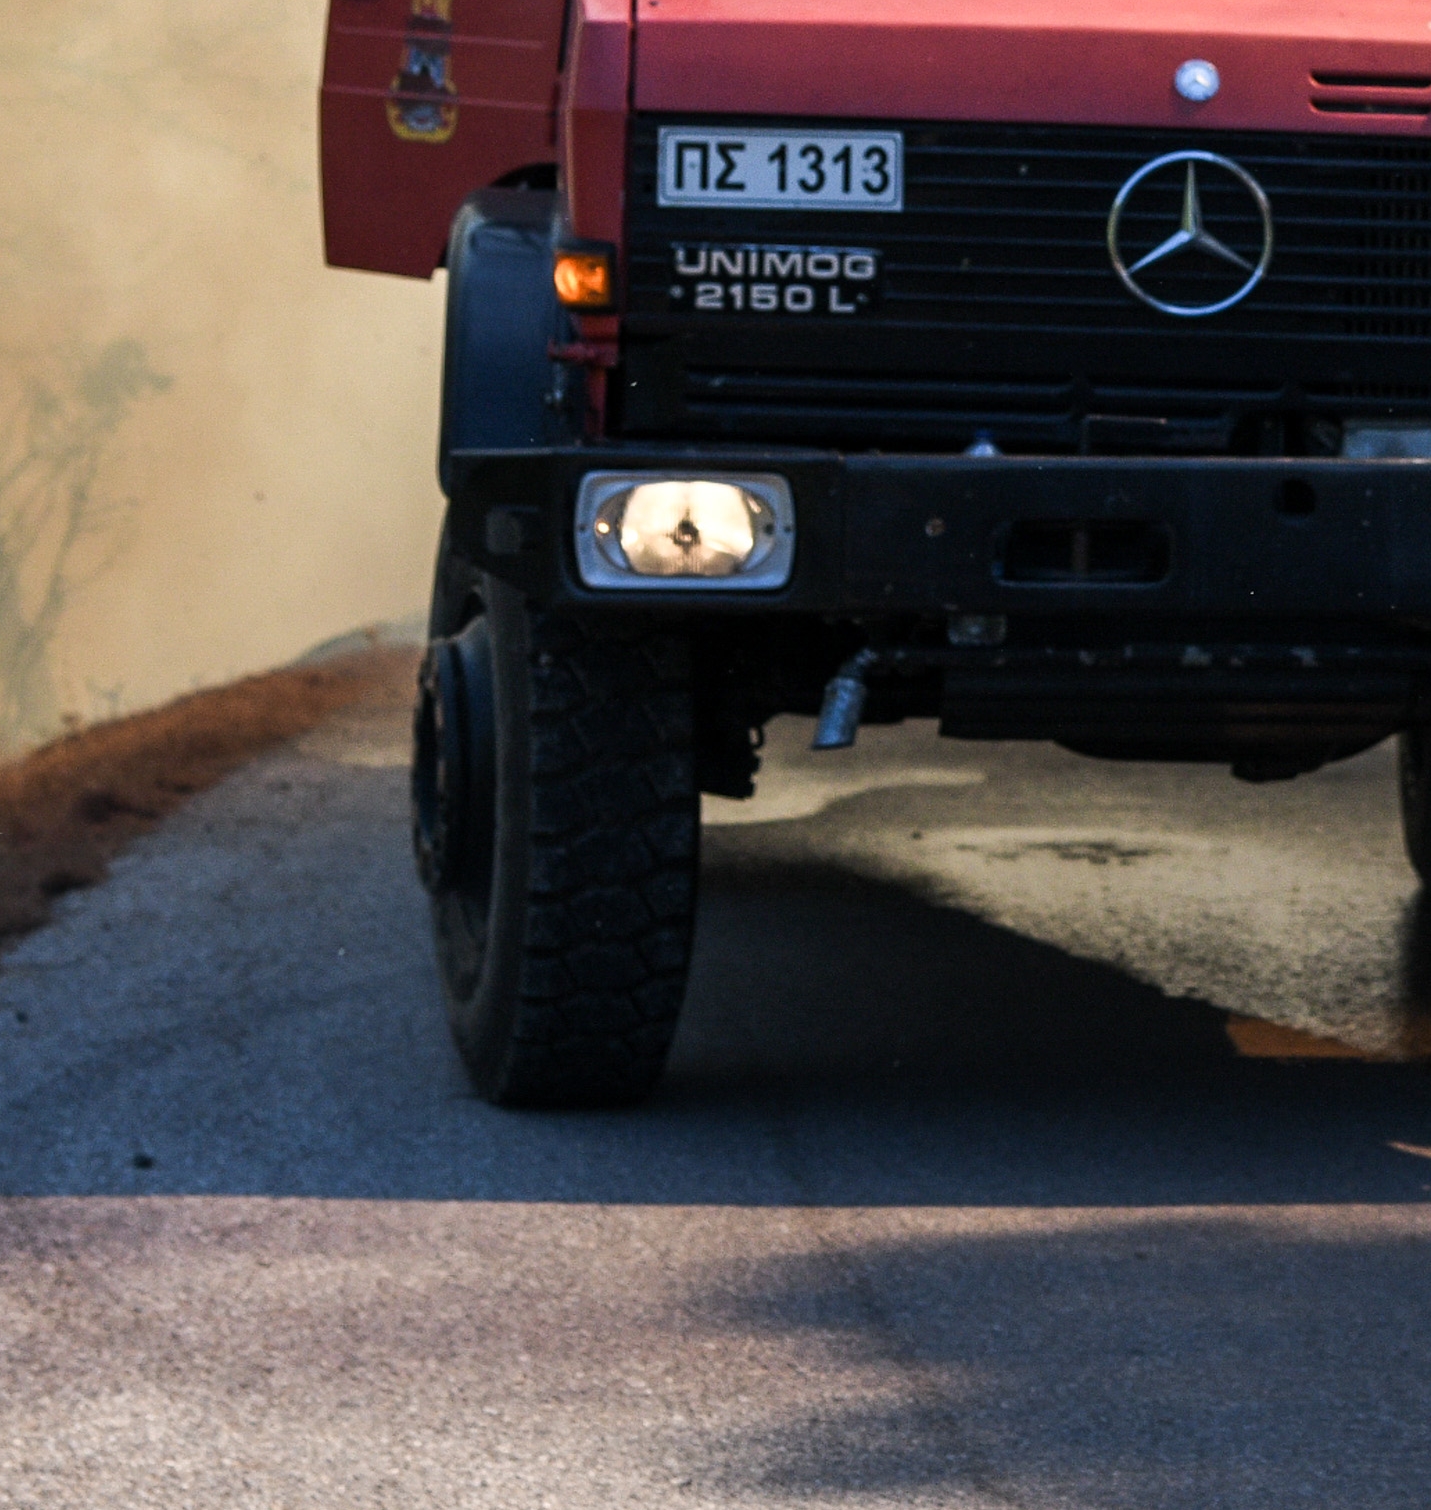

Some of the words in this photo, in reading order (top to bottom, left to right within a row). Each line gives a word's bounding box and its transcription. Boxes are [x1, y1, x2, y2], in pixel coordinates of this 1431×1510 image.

[674, 142, 746, 191] ΠΣ
[767, 144, 889, 195] 1313
[675, 247, 877, 280] UNIMOG
[694, 283, 814, 313] 2150
[829, 285, 856, 314] L
